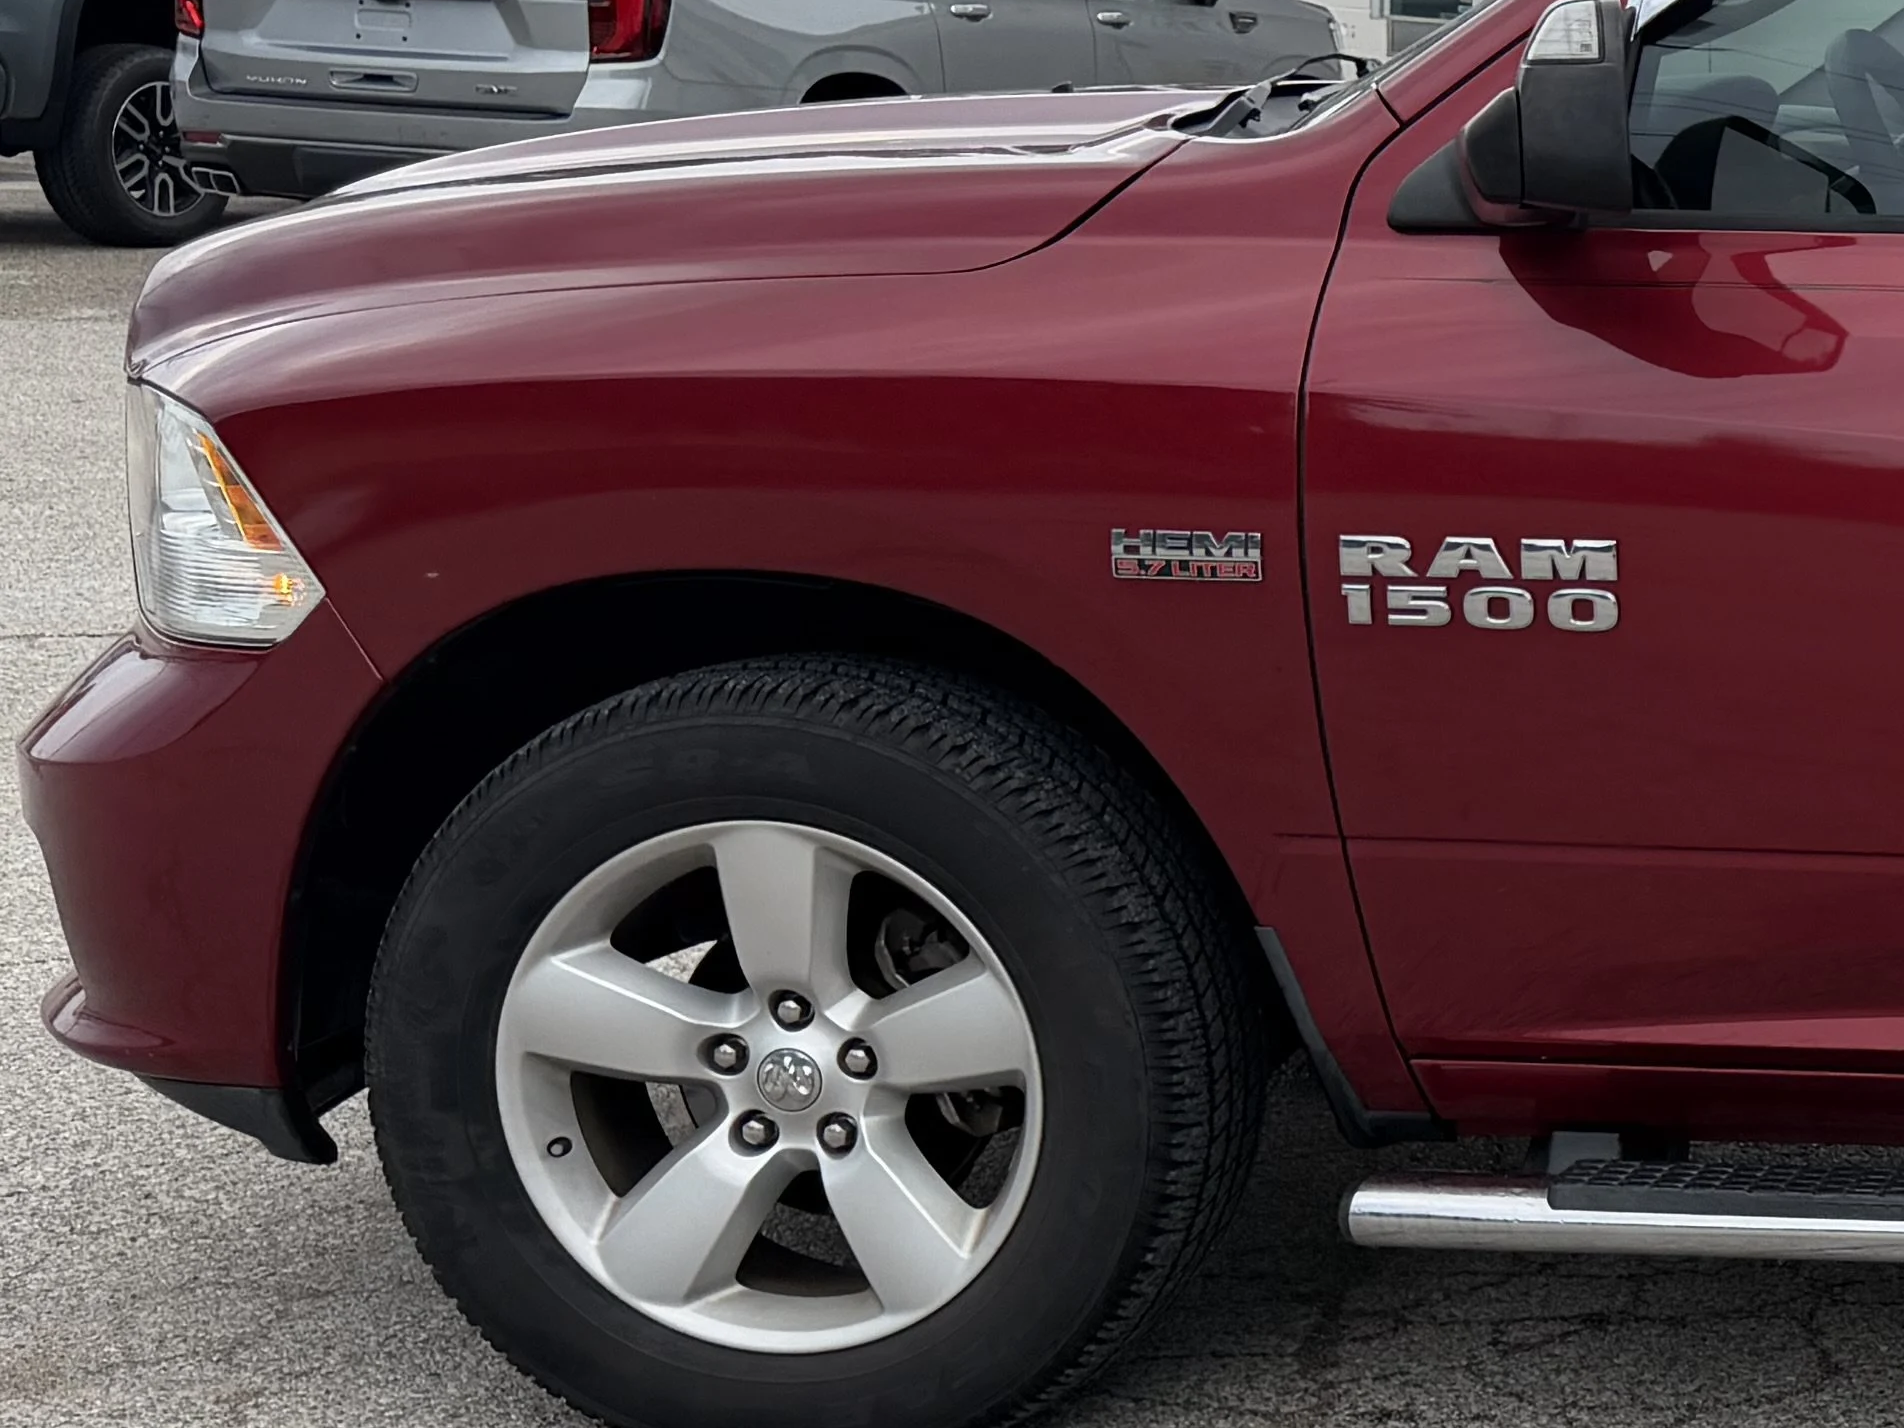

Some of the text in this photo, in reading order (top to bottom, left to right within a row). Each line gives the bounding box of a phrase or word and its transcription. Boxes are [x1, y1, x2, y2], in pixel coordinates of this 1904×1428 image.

[1111, 528, 1262, 558] HEMI
[1338, 534, 1618, 581] RAM
[1116, 558, 1257, 578] 5.7 LITER
[1340, 583, 1619, 632] 1500
